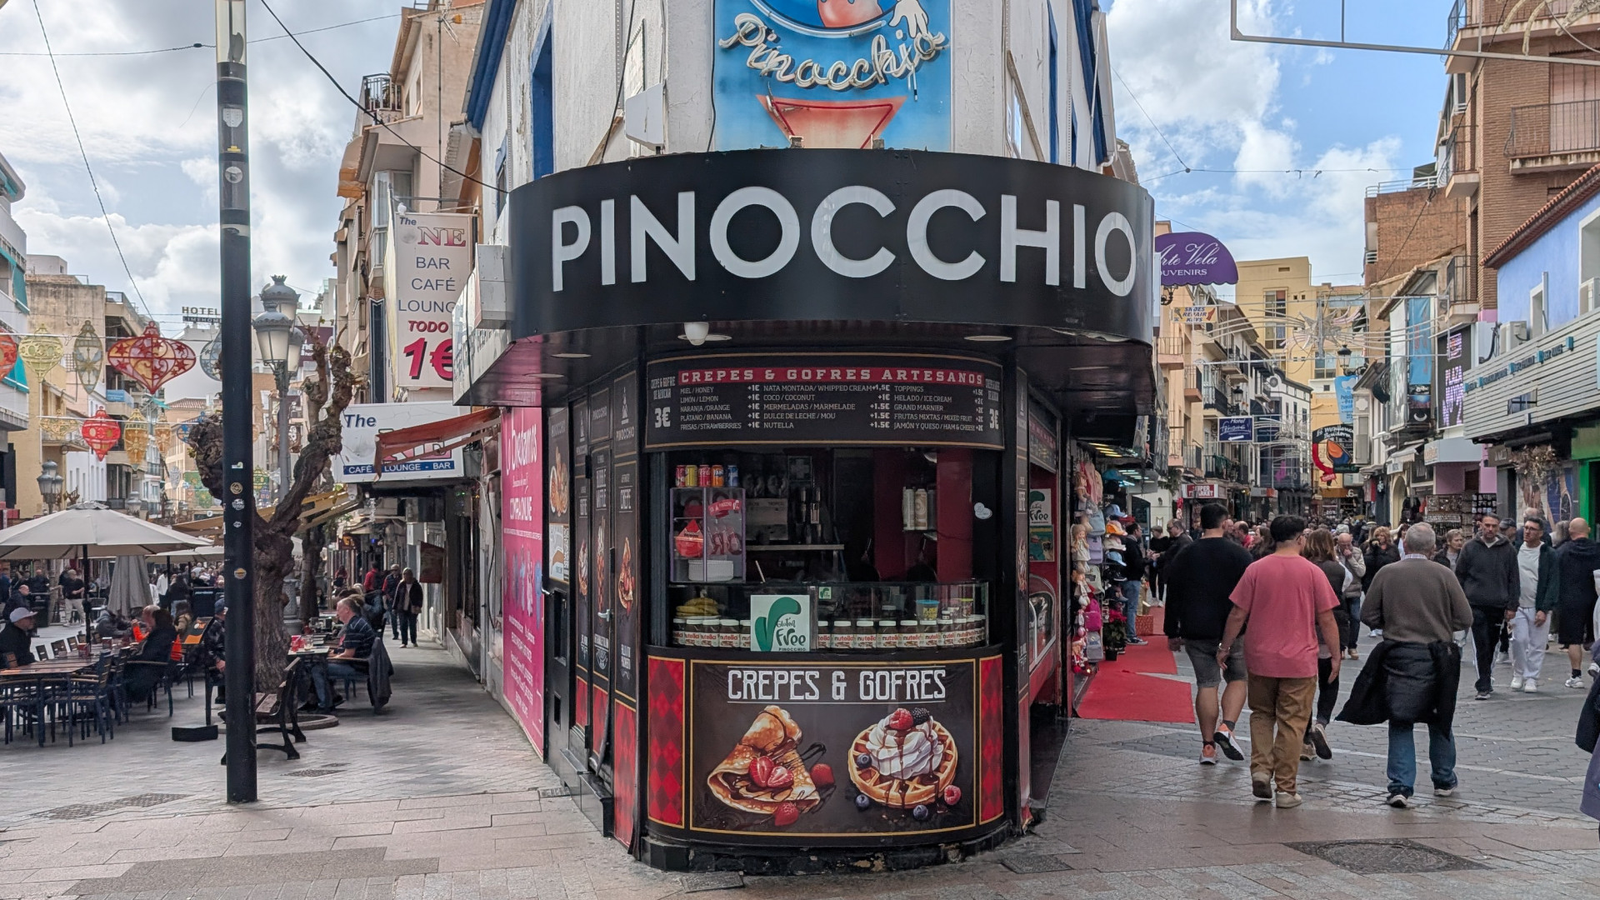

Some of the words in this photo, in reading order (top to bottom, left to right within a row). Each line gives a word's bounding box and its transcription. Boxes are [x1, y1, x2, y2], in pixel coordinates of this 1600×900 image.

[719, 13, 948, 90] Pinocchio
[400, 217, 417, 226] The
[552, 185, 1138, 297] PINOCCHIO
[1185, 242, 1220, 265] Vela
[416, 257, 450, 269] BAR
[411, 277, 456, 292] CAFÉ
[182, 306, 220, 316] HOTEL
[398, 300, 457, 313] LOUNG
[408, 320, 449, 333] TODO
[403, 337, 454, 381] 1€
[681, 369, 754, 383] CREPES
[765, 370, 775, 380] &
[787, 369, 871, 380] GOFRES
[881, 369, 983, 384] ARTESANOS
[344, 414, 376, 428] The
[654, 406, 671, 428] 3€
[989, 408, 999, 430] 3€
[700, 422, 742, 430] STRAWBERRIES
[894, 421, 915, 430] JAMÓN
[348, 465, 373, 474] CAFÉ
[384, 463, 421, 473] LOUNGE
[433, 462, 451, 470] BAR
[776, 628, 806, 646] Free
[727, 669, 820, 701] CREPES
[831, 670, 847, 701] &
[859, 669, 946, 701] GOFRES
